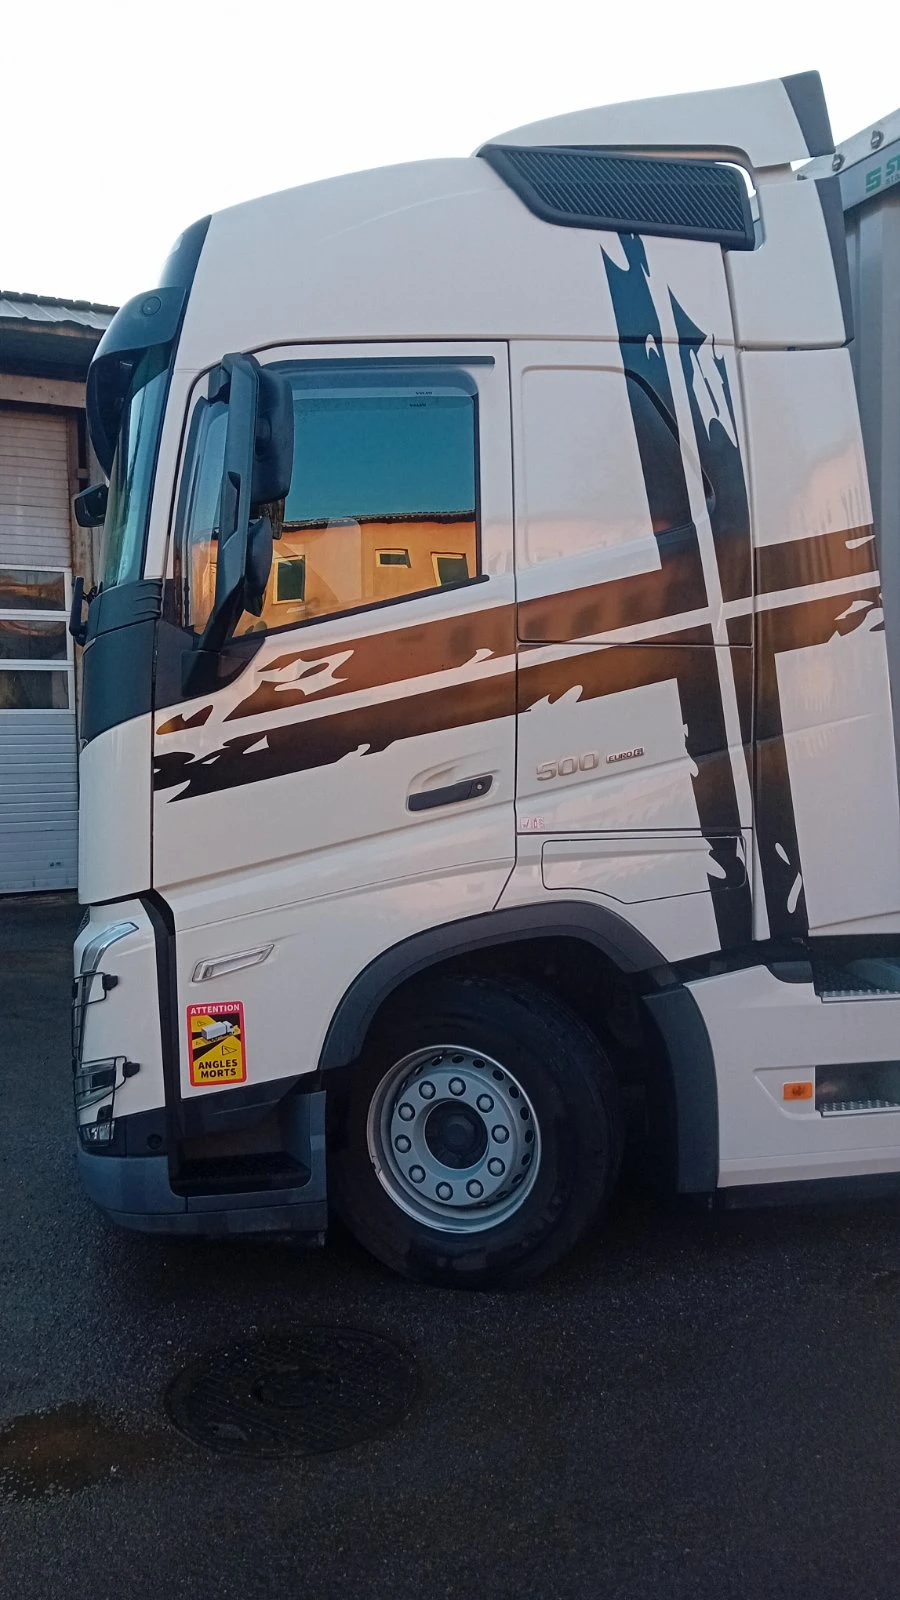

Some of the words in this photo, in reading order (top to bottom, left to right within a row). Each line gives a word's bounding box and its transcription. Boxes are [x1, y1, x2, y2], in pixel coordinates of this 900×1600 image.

[536, 752, 599, 781] 500
[608, 751, 632, 761] EURO
[190, 1004, 240, 1015] ATTENTION
[198, 1059, 238, 1070] ANGLES
[201, 1068, 237, 1079] MORTS
